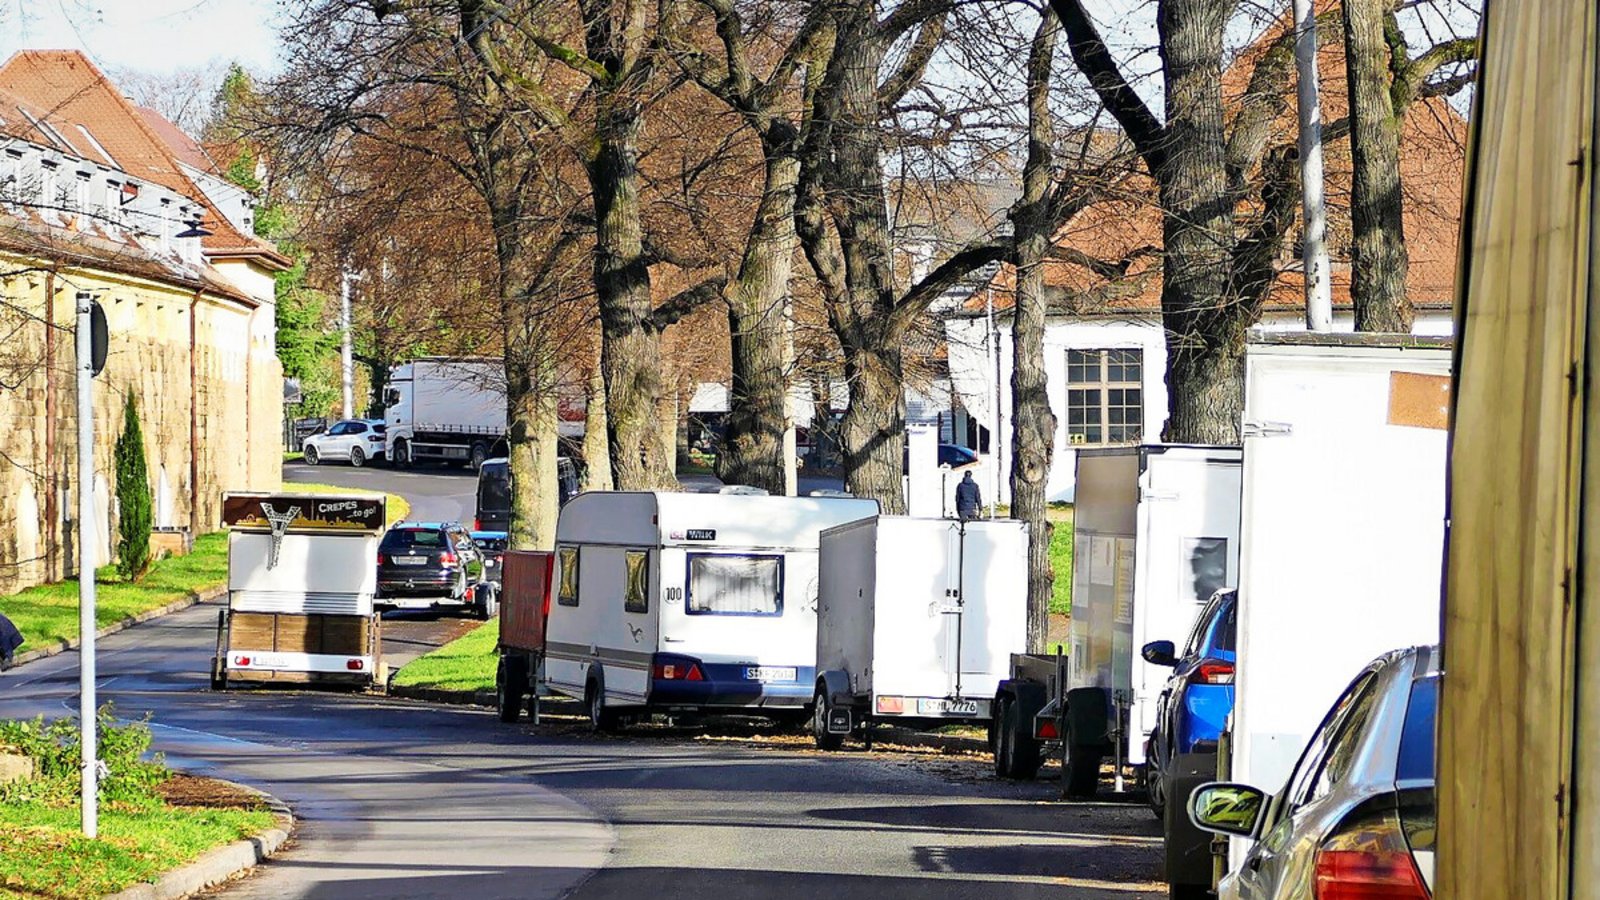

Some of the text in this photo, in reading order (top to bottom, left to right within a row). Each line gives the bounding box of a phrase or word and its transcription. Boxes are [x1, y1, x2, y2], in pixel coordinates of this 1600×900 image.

[688, 530, 713, 539] WILK
[665, 587, 682, 601] 100
[952, 700, 976, 712] 7776
